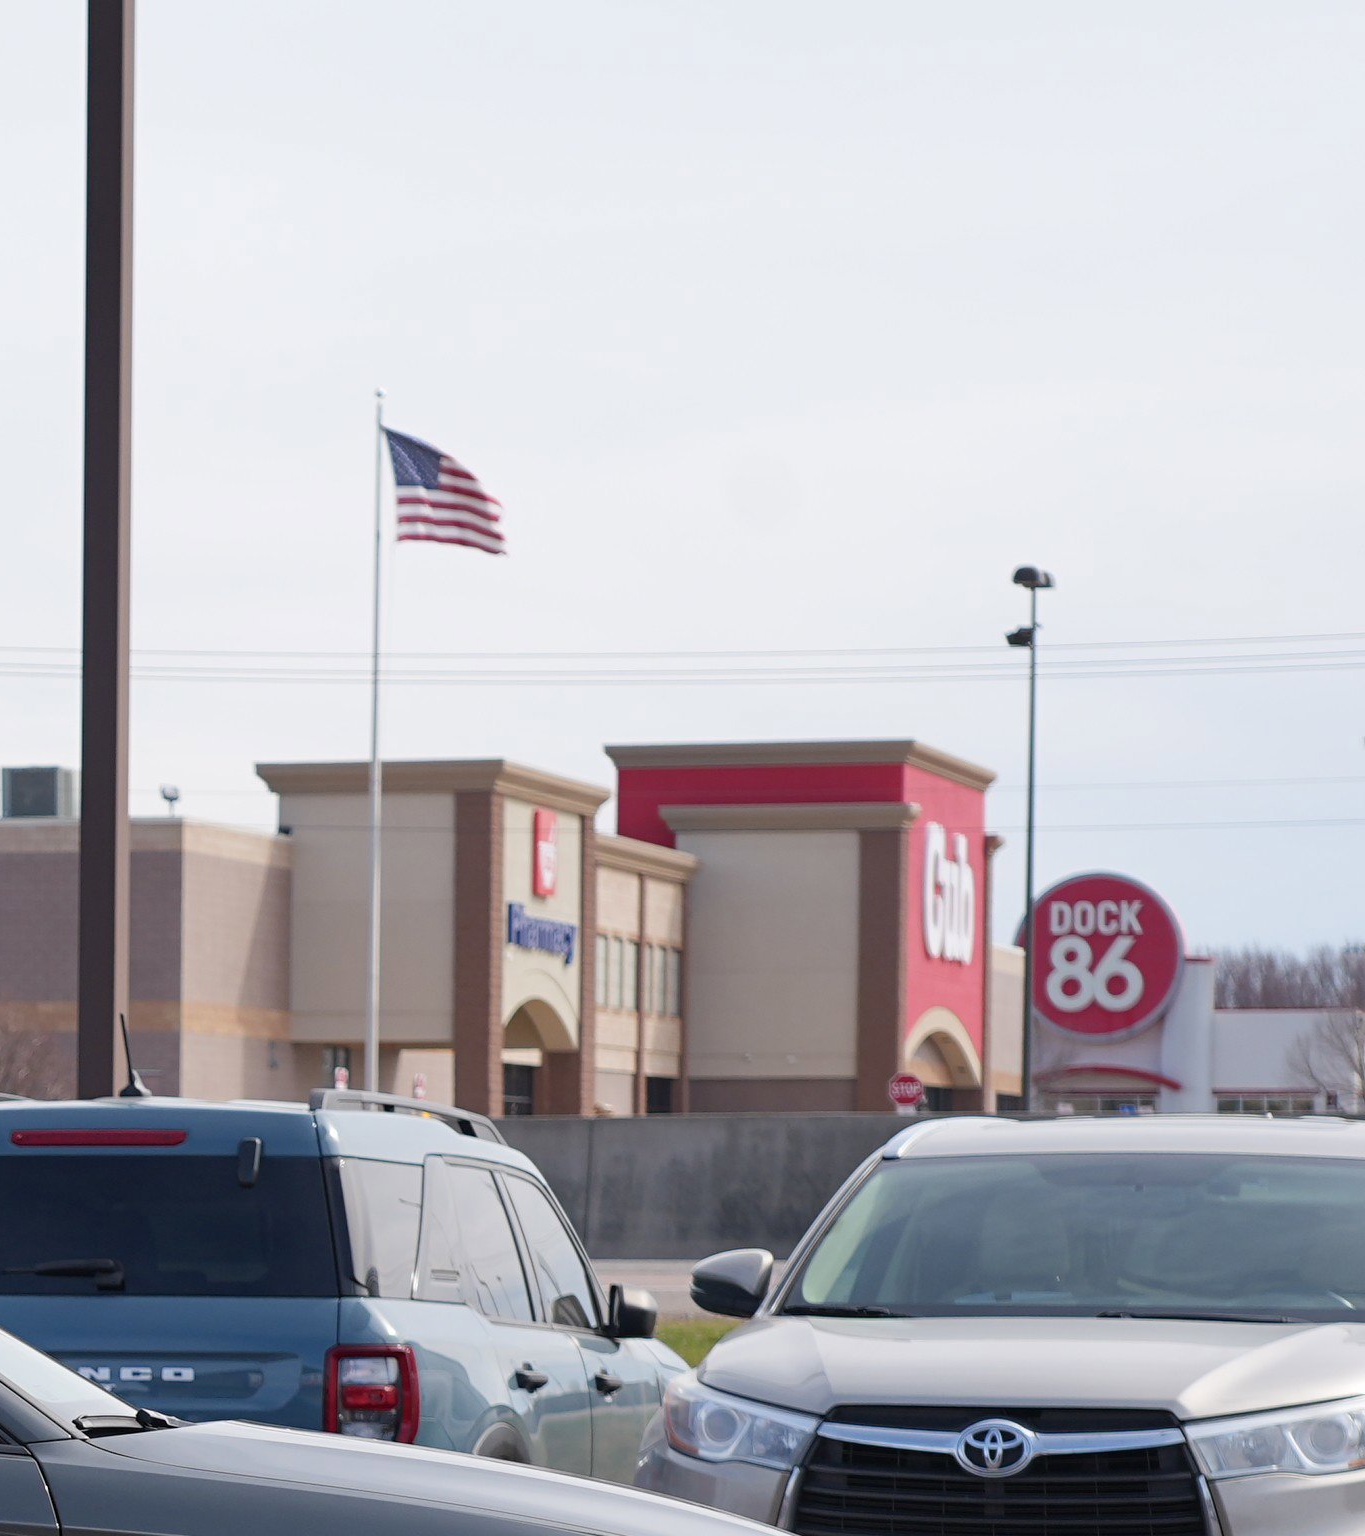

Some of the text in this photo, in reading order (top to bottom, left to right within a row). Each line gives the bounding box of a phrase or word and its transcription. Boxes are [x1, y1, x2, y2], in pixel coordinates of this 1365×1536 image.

[923, 820, 976, 967] Cub
[1049, 900, 1144, 938] DOCK
[1045, 935, 1145, 1013] 86
[891, 1081, 921, 1098] STOP
[77, 1366, 195, 1382] NCO
